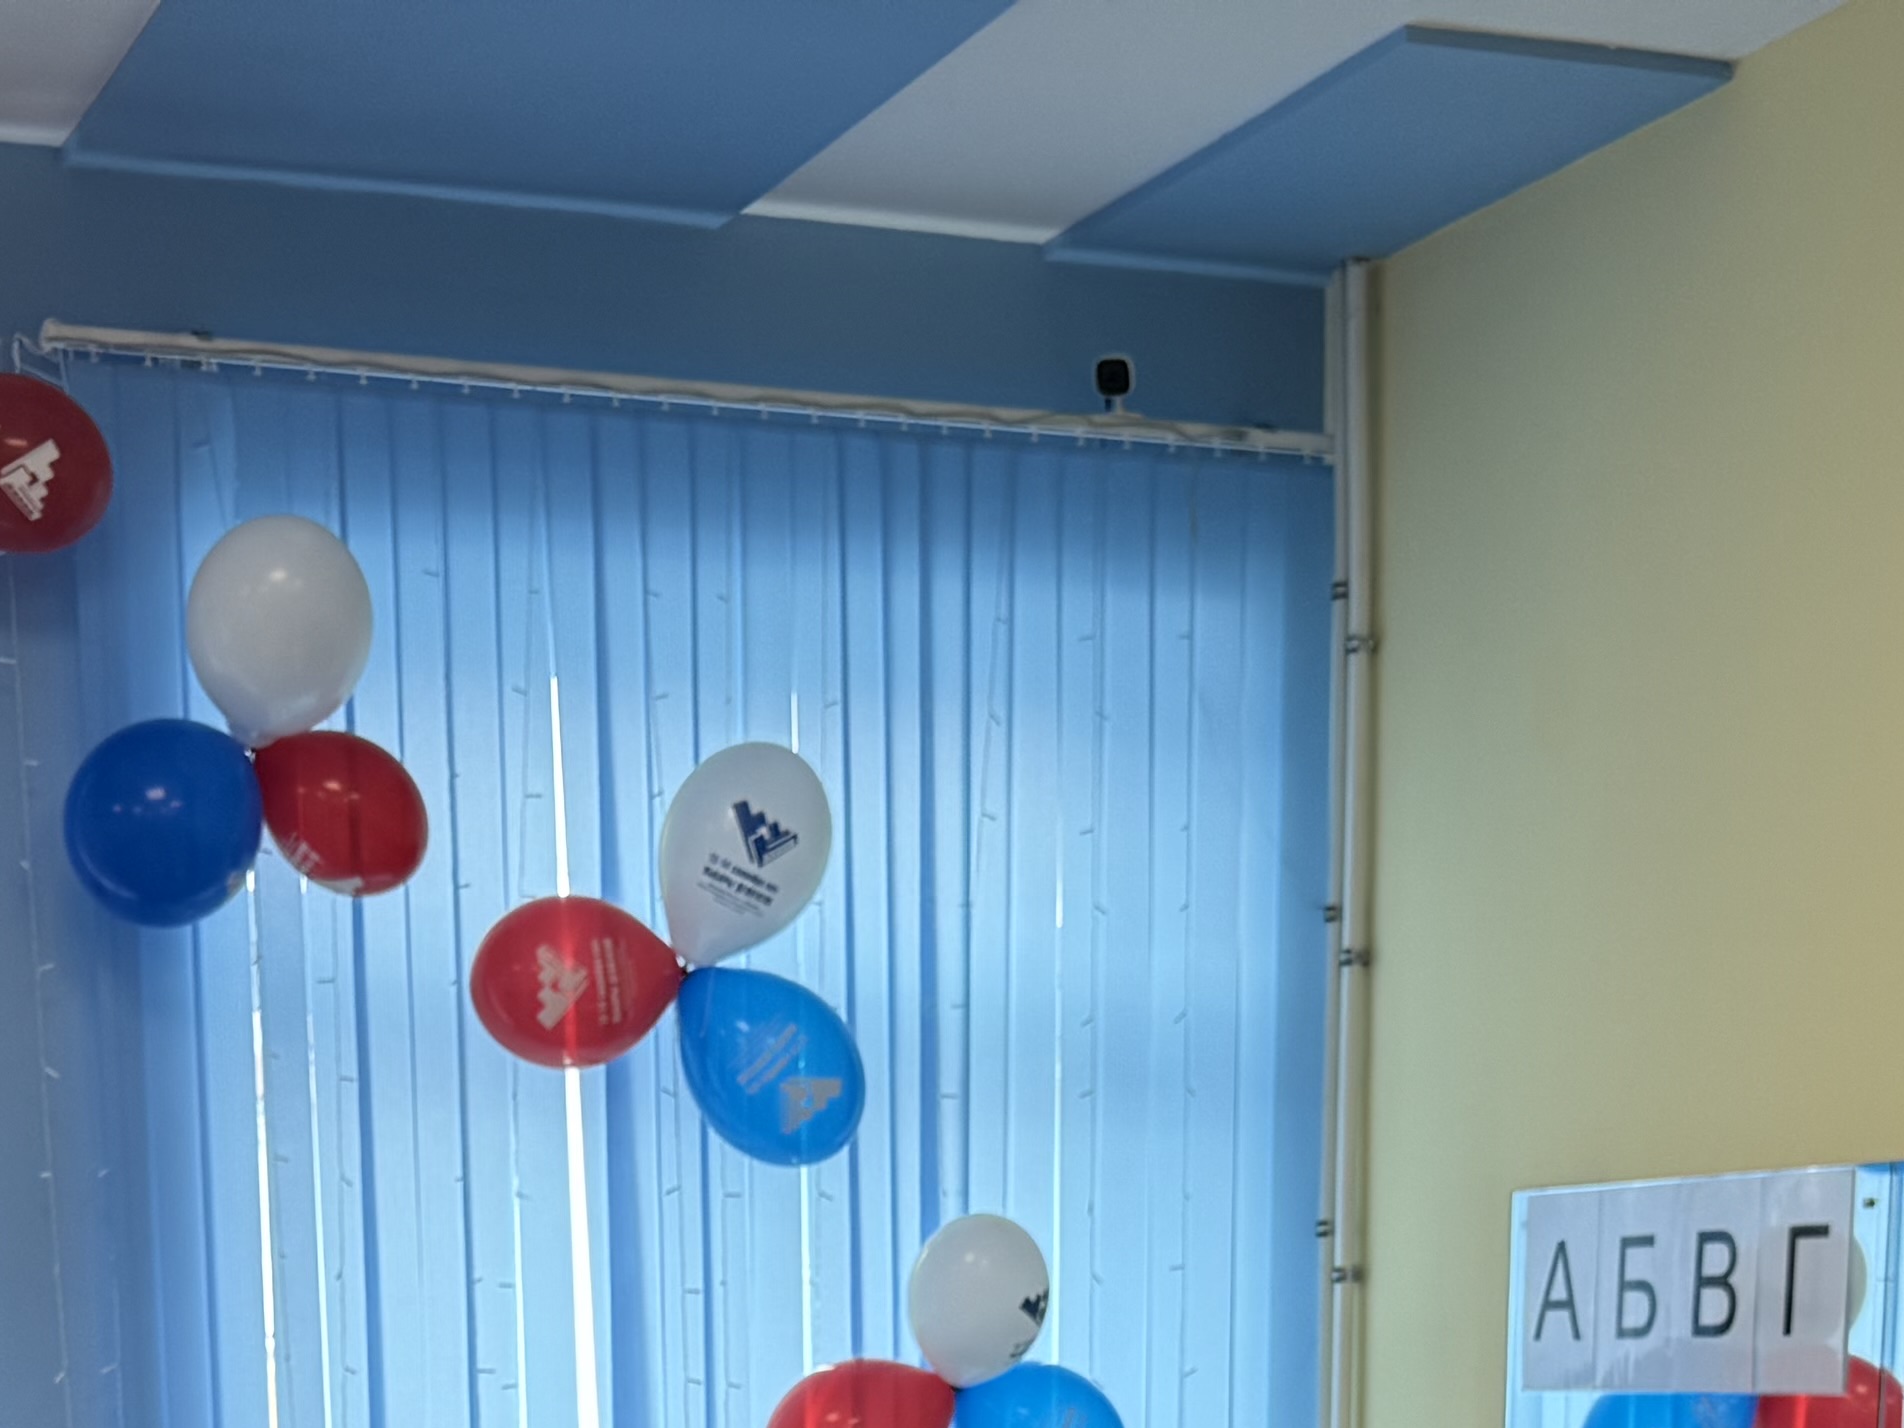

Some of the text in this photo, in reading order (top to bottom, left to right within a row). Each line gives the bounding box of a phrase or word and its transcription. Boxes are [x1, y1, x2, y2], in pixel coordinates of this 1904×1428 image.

[1532, 1224, 1831, 1342] А Б В Г
